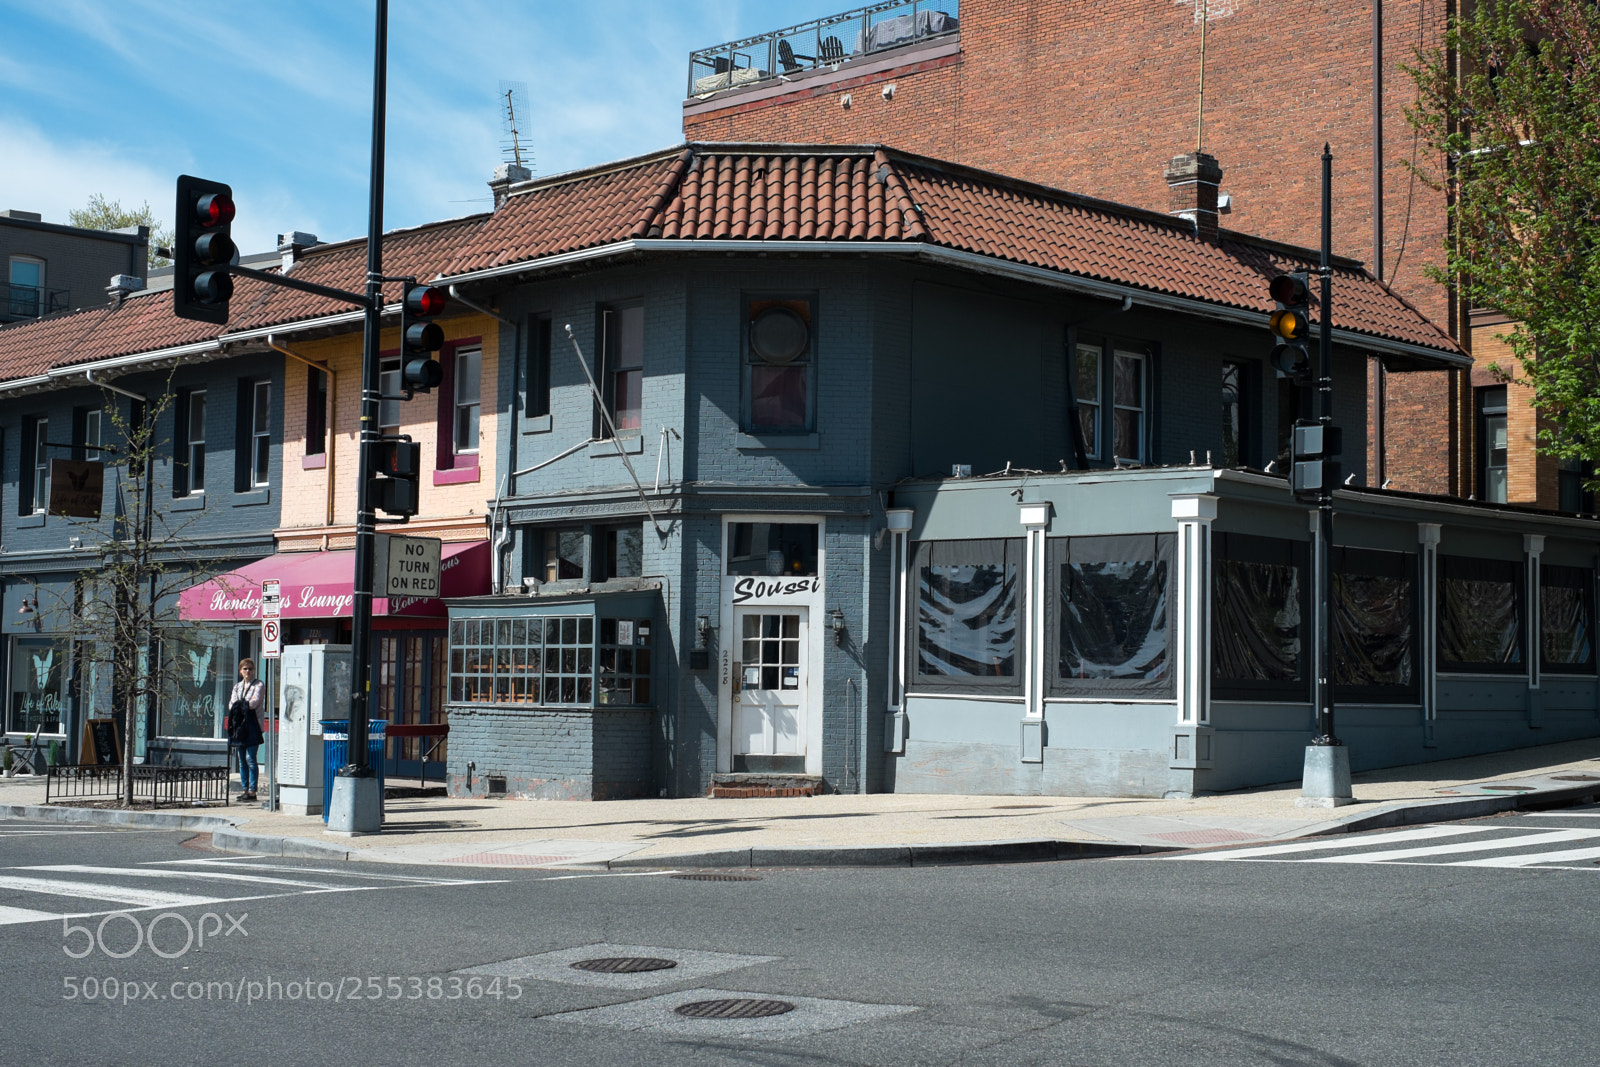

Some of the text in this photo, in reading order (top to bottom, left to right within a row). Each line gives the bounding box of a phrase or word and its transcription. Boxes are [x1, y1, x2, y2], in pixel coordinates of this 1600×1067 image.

[405, 544, 424, 556] NO
[399, 560, 429, 573] TURN
[391, 577, 436, 590] ON RED
[732, 576, 820, 603] Soussi
[297, 586, 353, 615] Lounge
